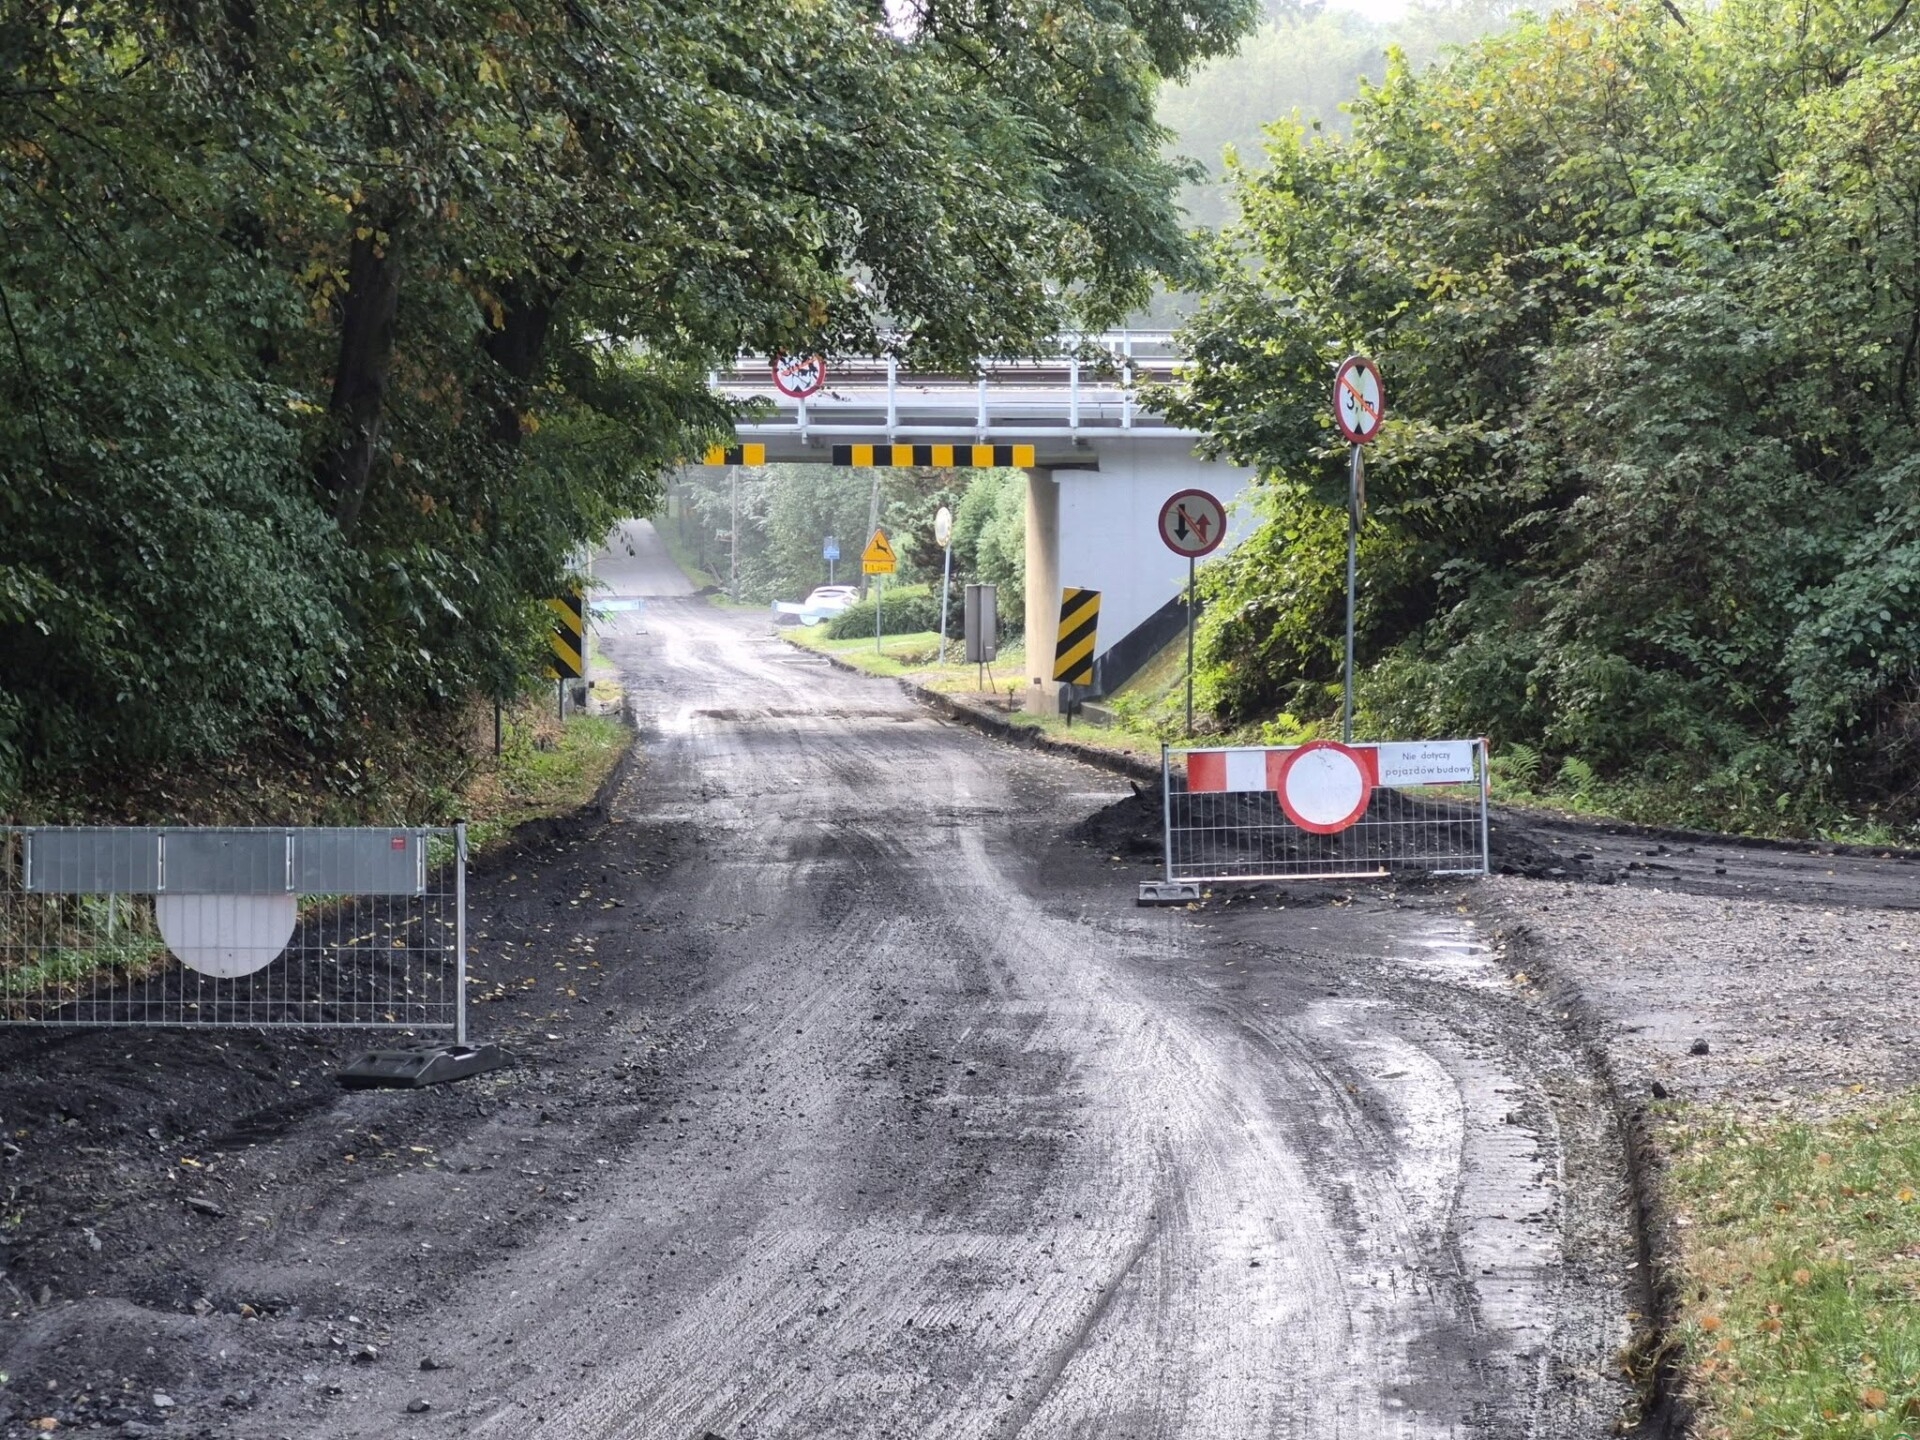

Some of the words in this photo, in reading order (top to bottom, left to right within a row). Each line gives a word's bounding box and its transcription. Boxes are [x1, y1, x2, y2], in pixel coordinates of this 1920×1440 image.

[1402, 752, 1417, 761] Nie
[1421, 751, 1451, 761] dotyczy
[1385, 766, 1435, 777] pojazdów
[1436, 765, 1471, 775] budowy
